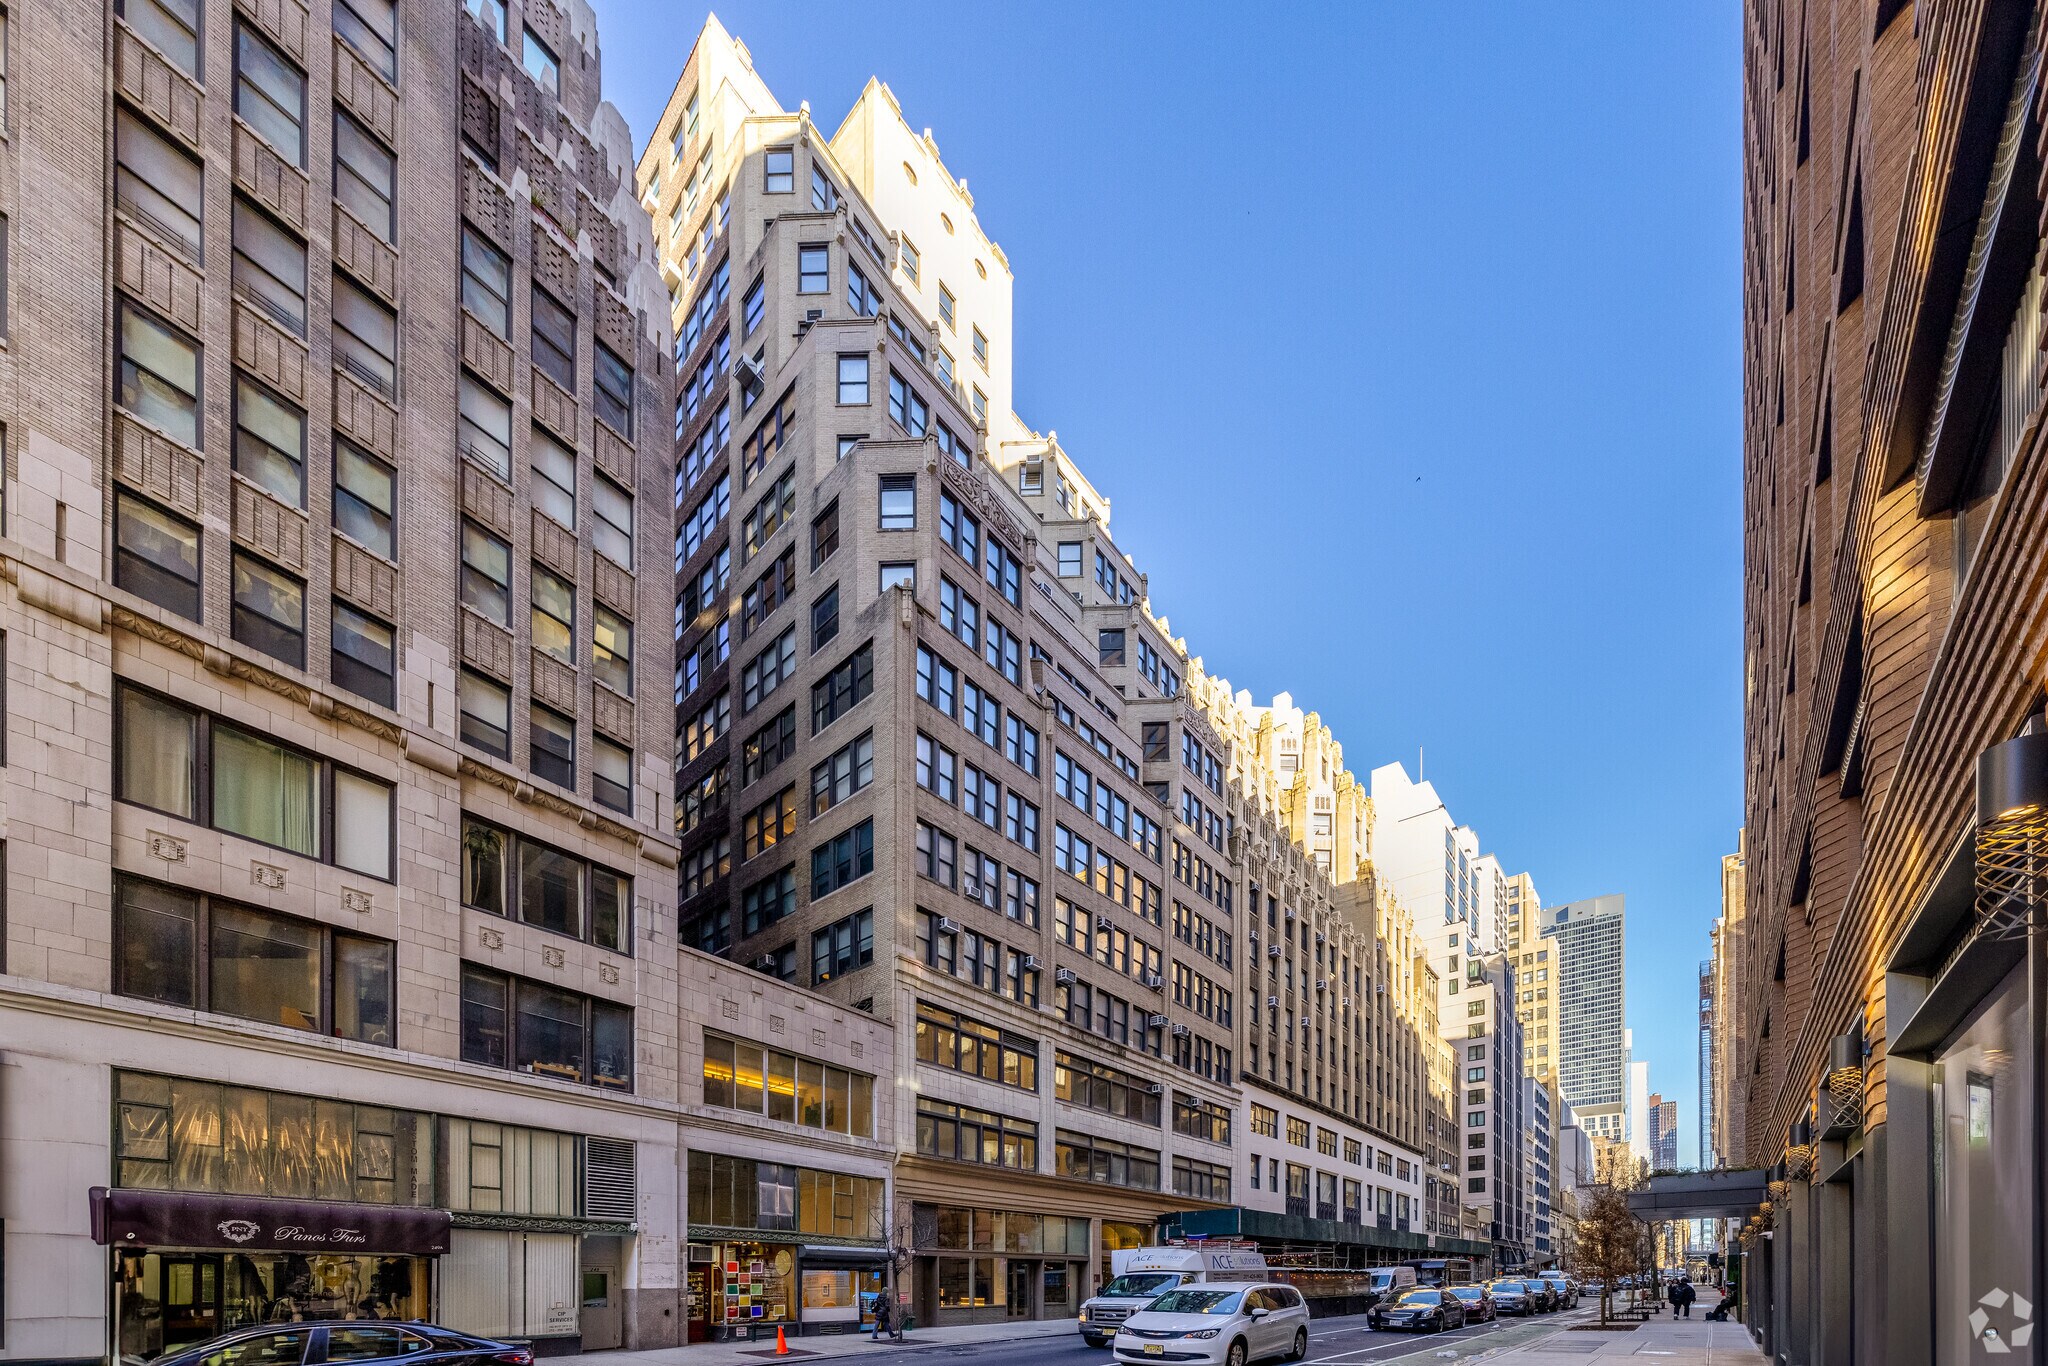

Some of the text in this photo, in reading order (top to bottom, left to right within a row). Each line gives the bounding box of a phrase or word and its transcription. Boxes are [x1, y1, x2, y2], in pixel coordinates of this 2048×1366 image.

[274, 1225, 366, 1243] Panos Furs
[1131, 1254, 1154, 1262] ACE
[1212, 1255, 1235, 1269] ACE
